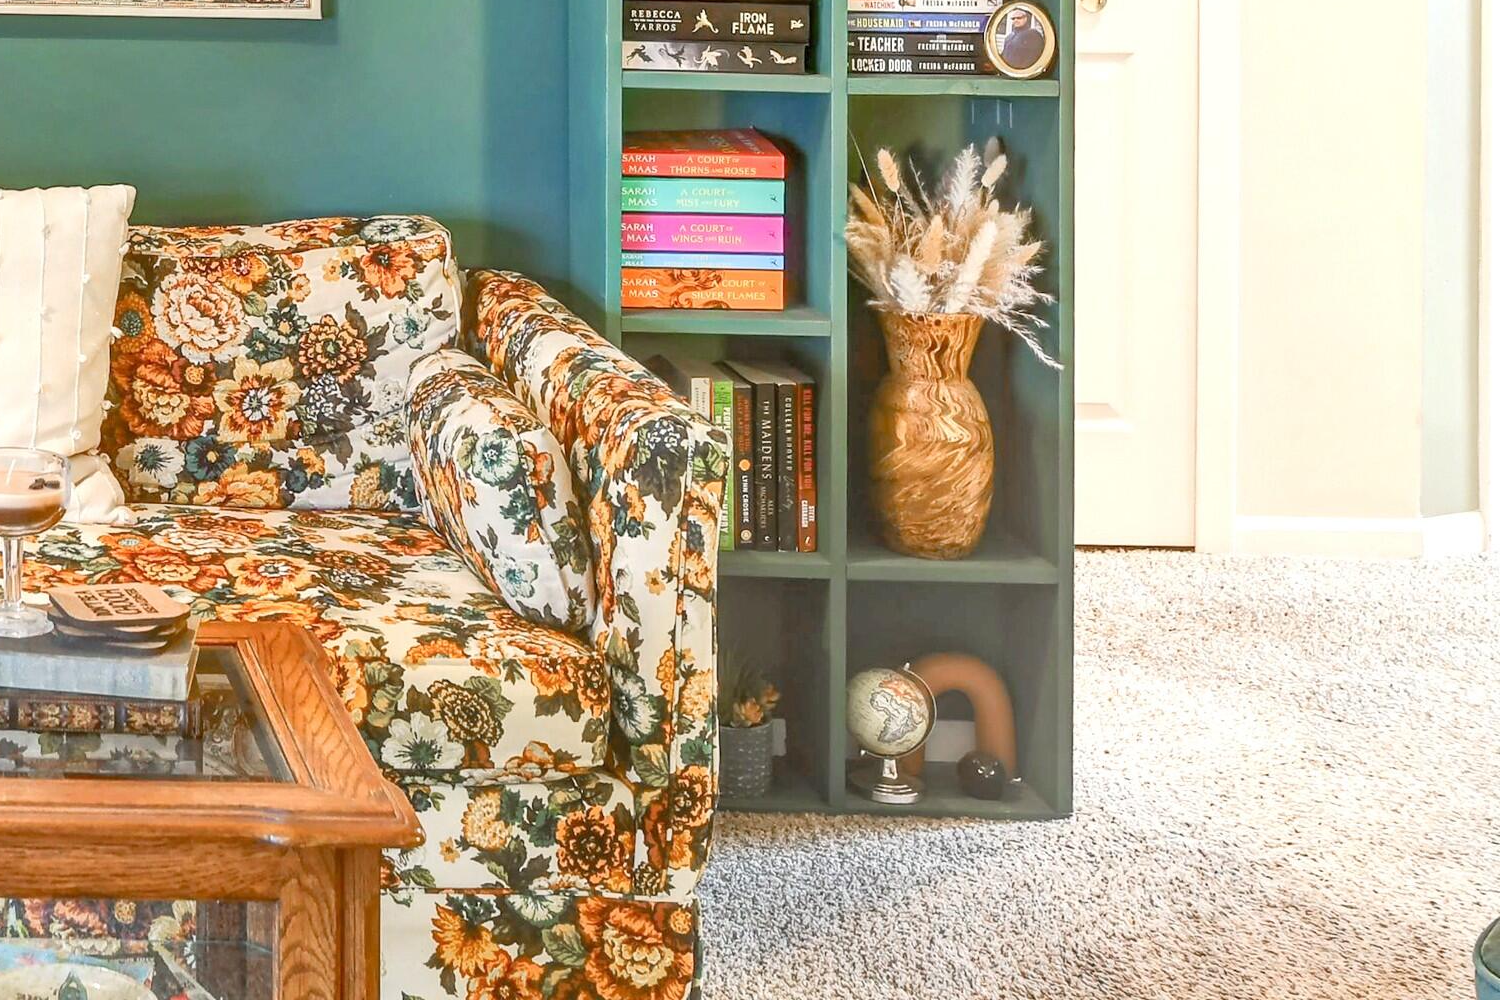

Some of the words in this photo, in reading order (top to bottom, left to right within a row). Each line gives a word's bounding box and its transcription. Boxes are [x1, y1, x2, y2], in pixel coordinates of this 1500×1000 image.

[864, 1, 895, 9] WATCHING
[631, 10, 682, 19] REBECCA
[740, 12, 767, 23] IRON
[635, 23, 677, 32] YARROS
[857, 19, 904, 28] HOUSEMAID
[732, 23, 774, 36] FLAME
[858, 37, 904, 52] TEACHER
[851, 59, 886, 72] LOCKED
[888, 60, 913, 72] DOOR
[629, 166, 658, 174] MAAS
[676, 199, 699, 207] MIST
[714, 199, 740, 207] FURY
[626, 234, 656, 242] MAAS
[629, 290, 659, 298] MAAS
[692, 292, 724, 300] SILVER
[728, 292, 766, 300] FLAMES
[784, 397, 793, 434] COLLEEN
[761, 419, 773, 480] MAIDENS
